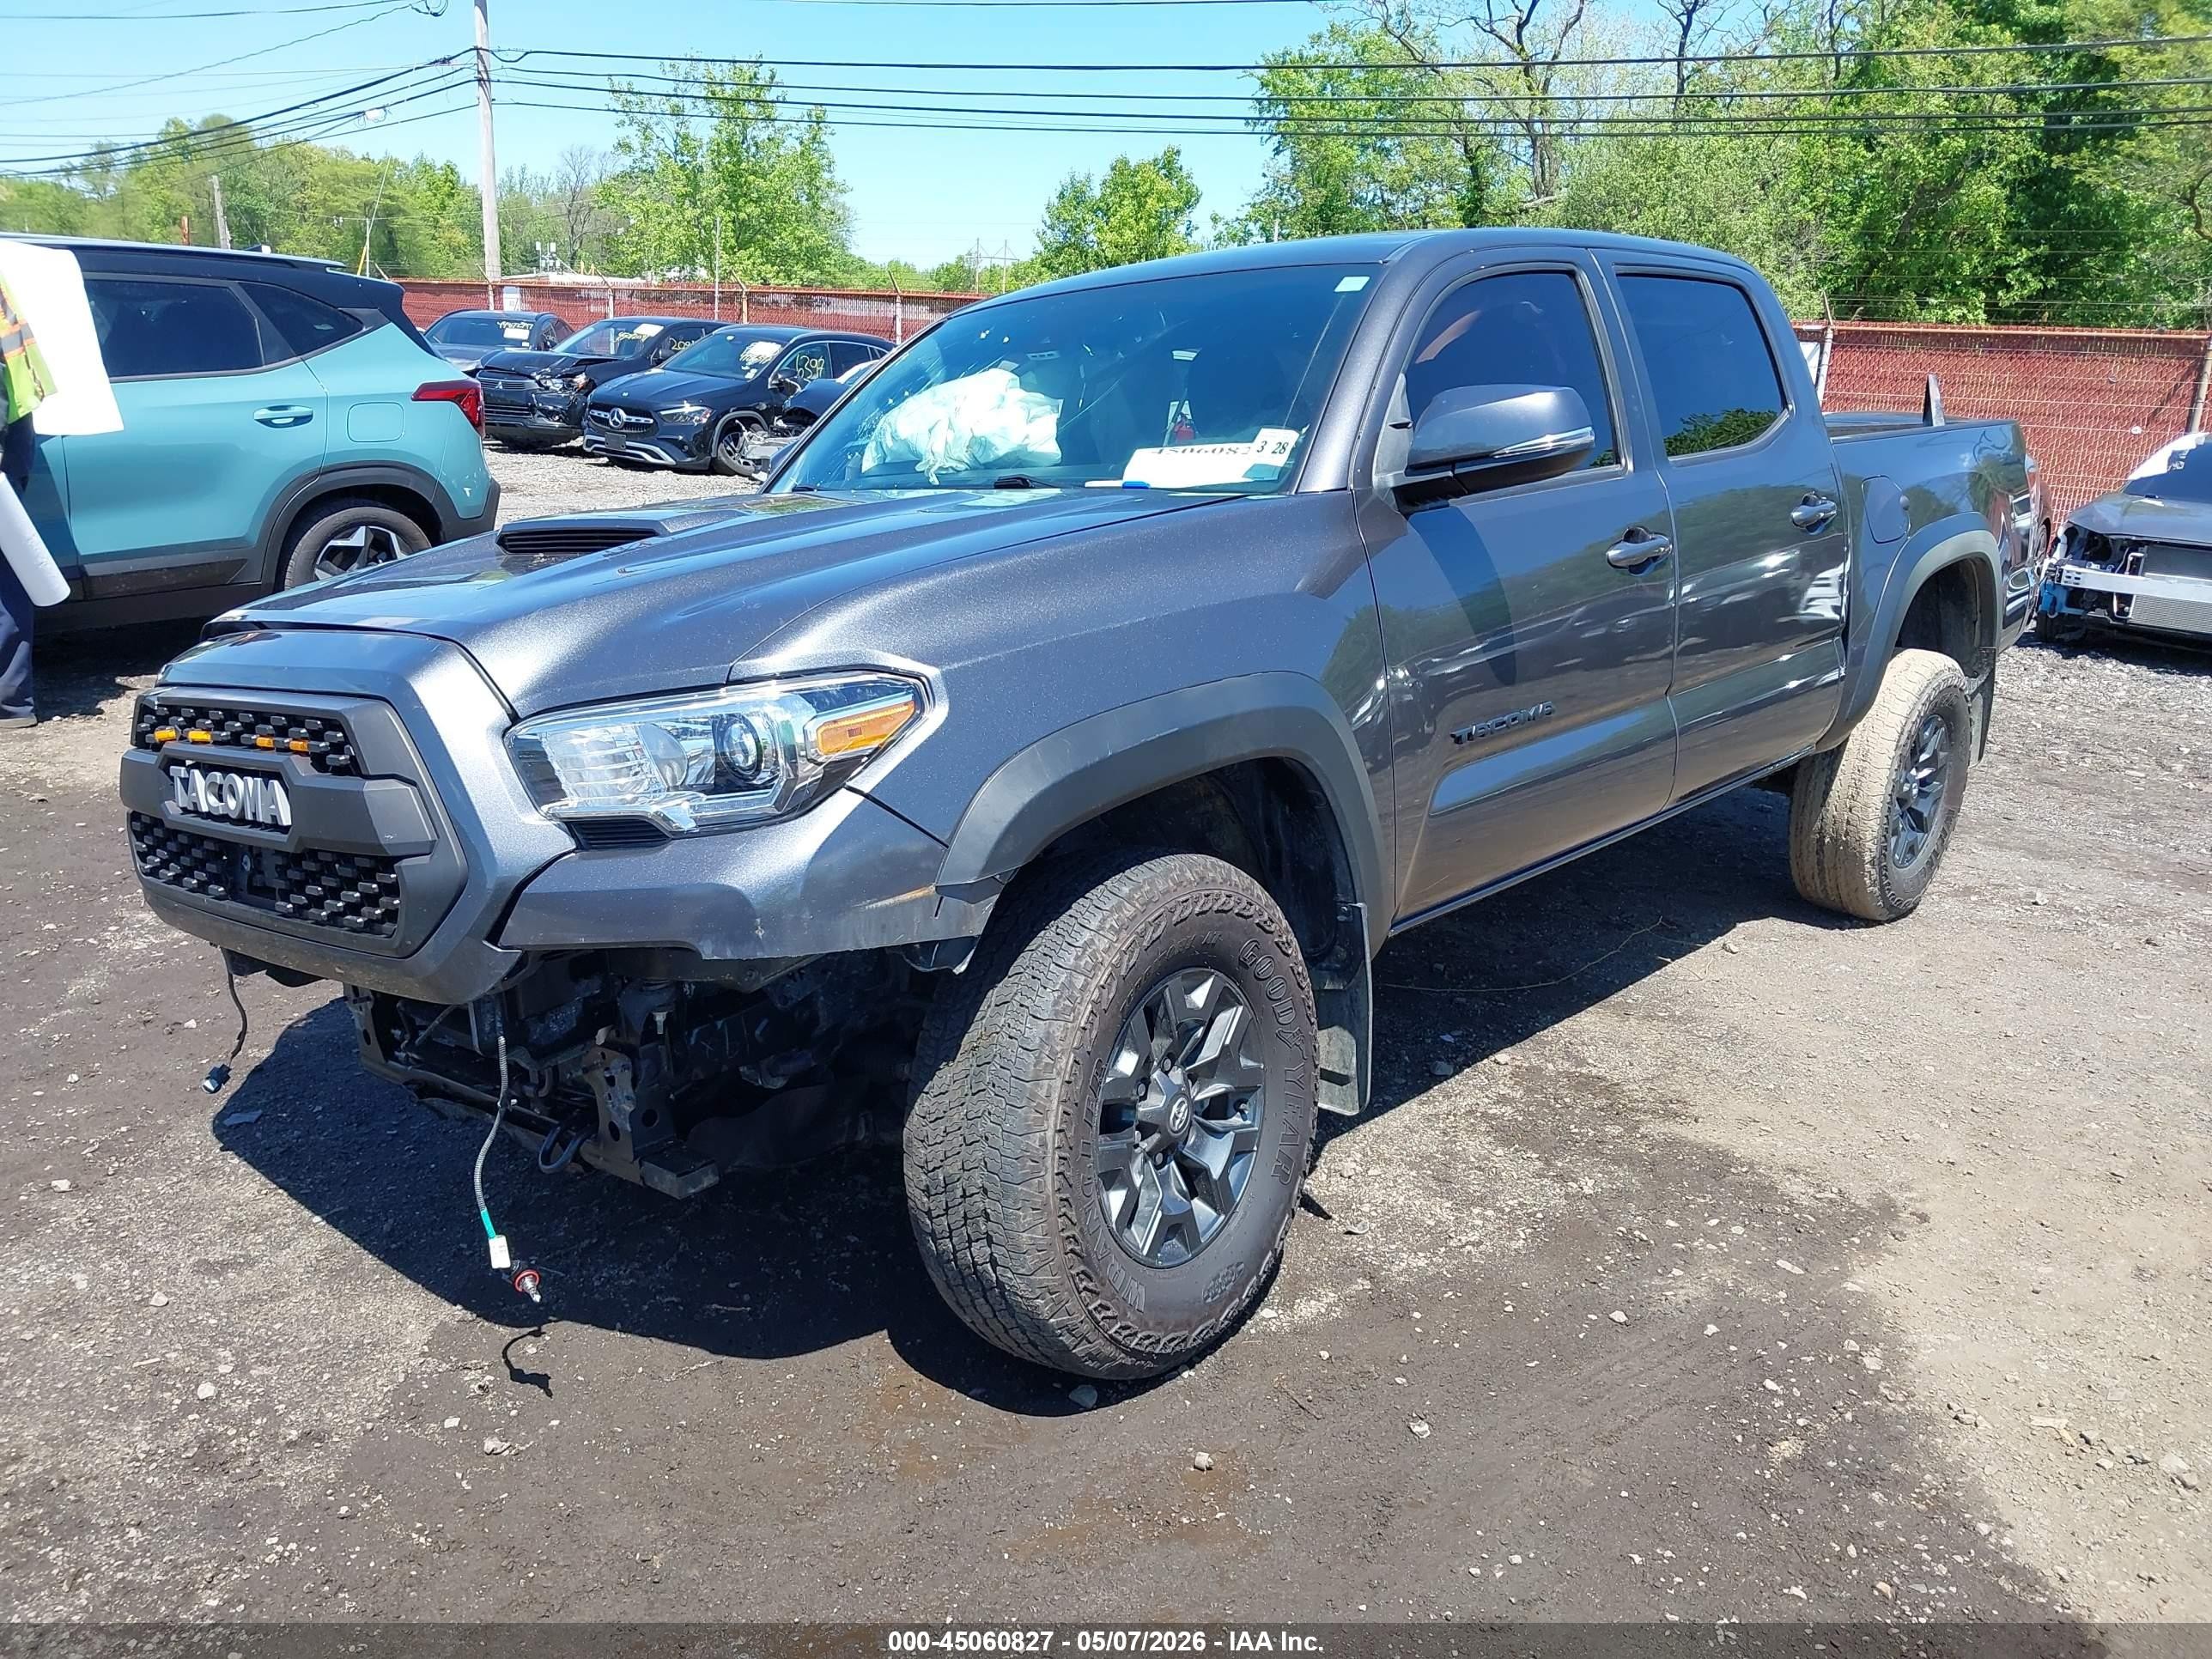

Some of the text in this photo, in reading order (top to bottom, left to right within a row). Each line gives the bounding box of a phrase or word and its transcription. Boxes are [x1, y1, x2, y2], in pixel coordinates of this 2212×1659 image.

[1256, 440, 1289, 454] 3 28
[1449, 701, 1553, 744] TACOMA
[169, 765, 292, 827] TACOMA
[1239, 938, 1306, 1187] GOODYEAR
